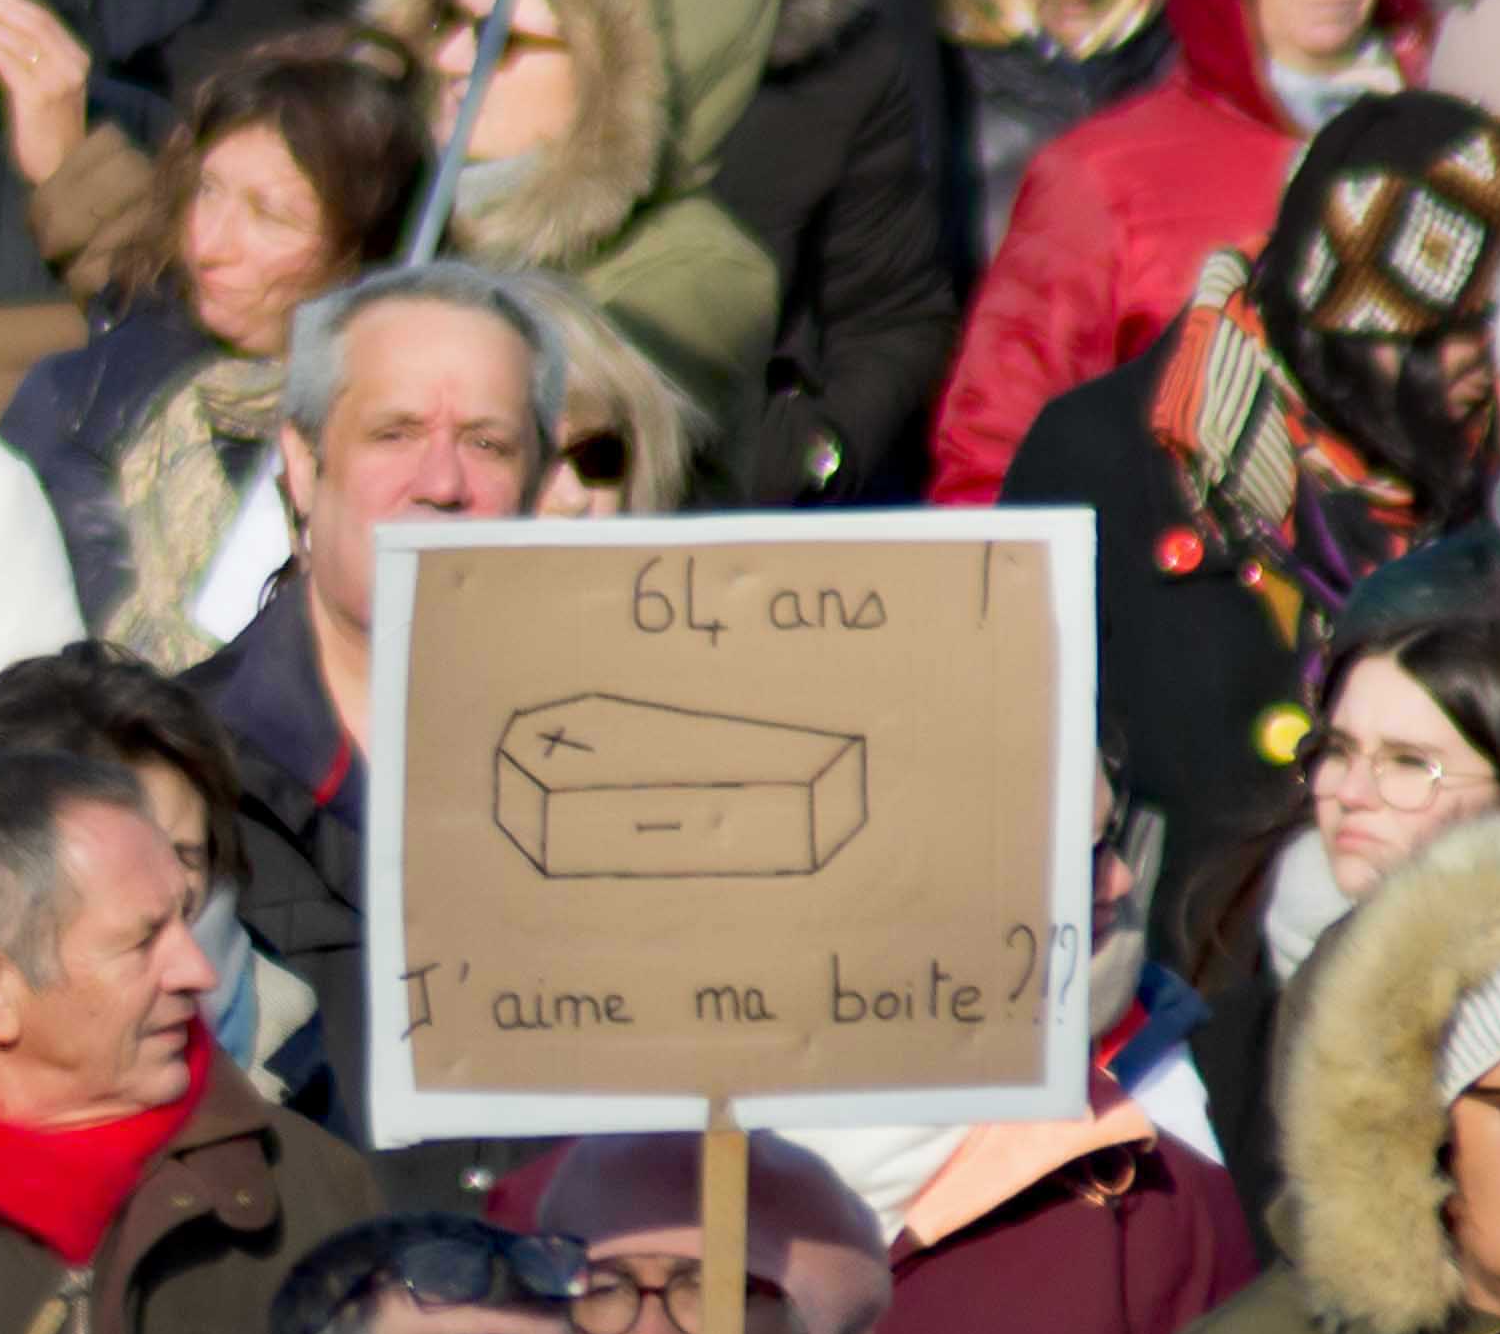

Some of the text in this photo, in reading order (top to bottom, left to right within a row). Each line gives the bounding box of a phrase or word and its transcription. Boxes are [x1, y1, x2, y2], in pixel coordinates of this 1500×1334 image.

[632, 554, 729, 649] 64
[768, 587, 888, 632] ans
[694, 984, 780, 1023] ma
